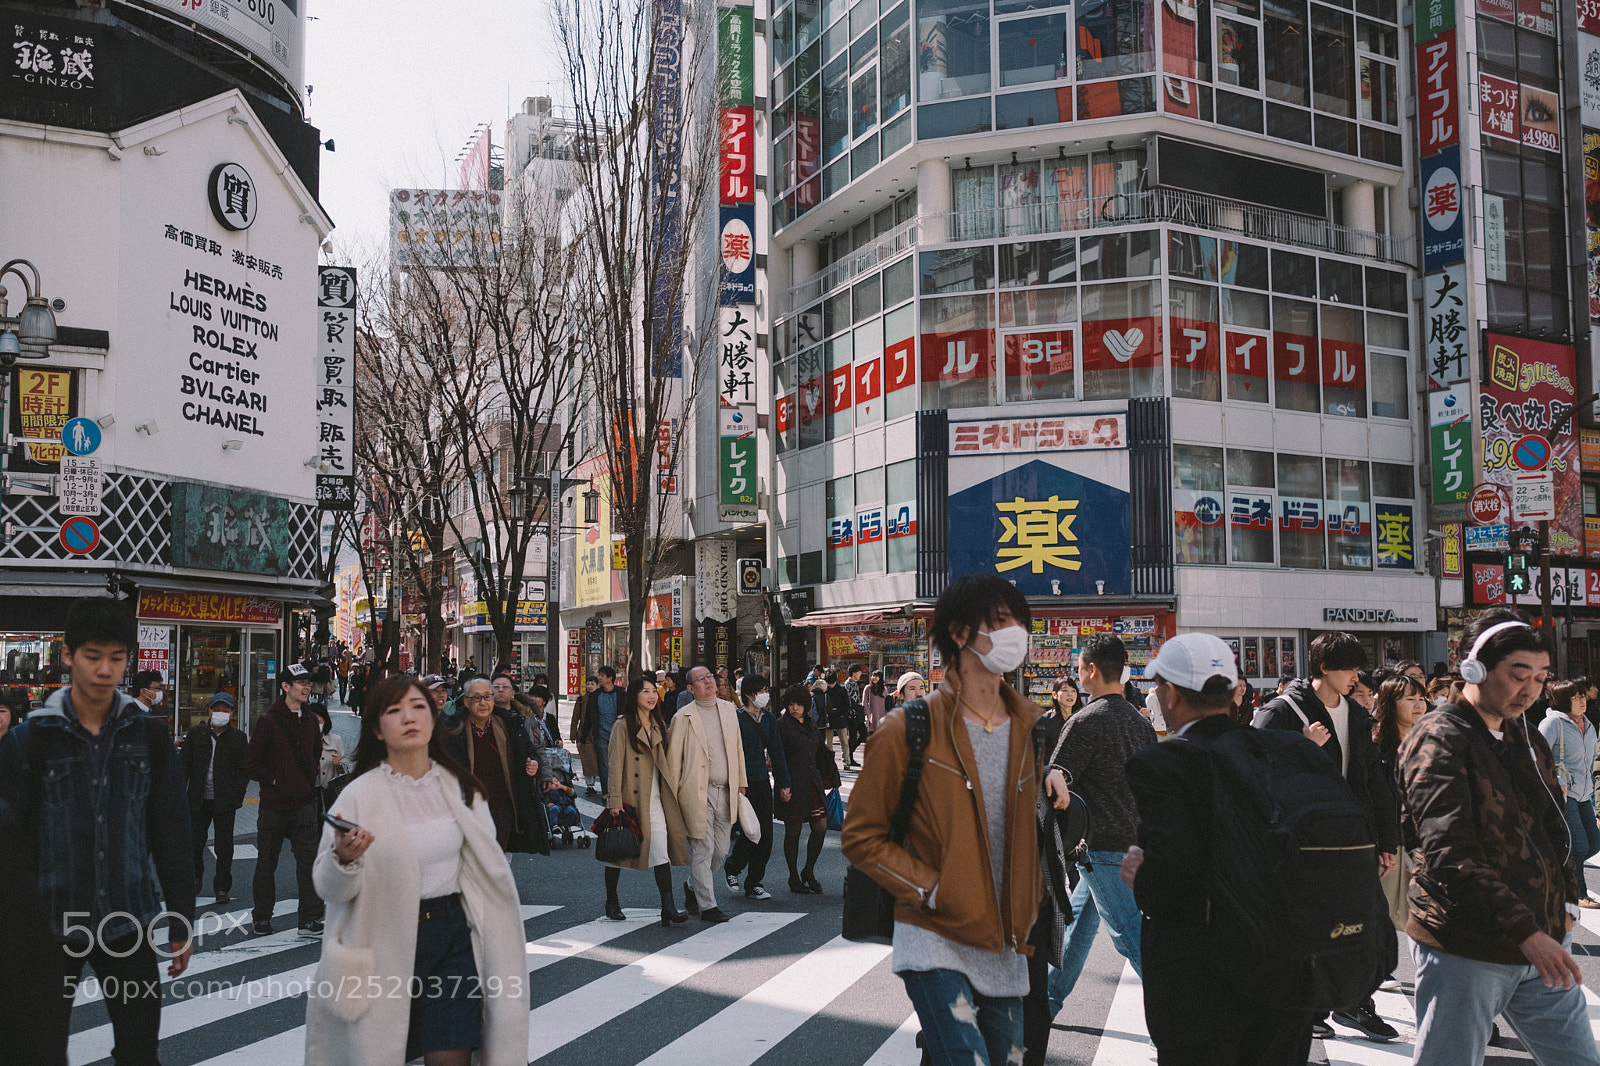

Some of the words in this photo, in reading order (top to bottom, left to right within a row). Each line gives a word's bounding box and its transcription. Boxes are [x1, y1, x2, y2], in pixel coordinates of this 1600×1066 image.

[24, 73, 83, 90] GINZO
[1425, 41, 1453, 145] アイフル
[1480, 80, 1519, 111] まつげ
[727, 113, 749, 198] アイフル
[224, 171, 251, 223] 質
[1427, 182, 1458, 218] 薬
[164, 224, 223, 257] 高価買取
[231, 249, 284, 282] 激安販売
[723, 233, 751, 260] 薬
[183, 268, 268, 313] HERMÈS
[320, 272, 351, 304] 質
[169, 291, 213, 322] LOUIS
[220, 307, 279, 342] VUITTON
[1428, 273, 1469, 380] 大勝軒
[192, 324, 258, 361] ROLEX
[721, 309, 755, 401] 大勝軒
[1021, 339, 1062, 364] 3F
[1182, 327, 1356, 383] アイフル
[189, 351, 261, 386] Cartier
[1495, 366, 1515, 387] 焼肉
[1496, 351, 1516, 372] 炭火
[28, 372, 61, 395] 2F
[180, 374, 268, 414] BVLGARI
[21, 395, 66, 415] 時計
[182, 401, 265, 437] CHANEL
[779, 402, 793, 423] 3F
[729, 441, 747, 495] レイク
[1442, 430, 1463, 493] レイク
[320, 477, 345, 487] 2号店
[1516, 486, 1528, 495] 22
[551, 482, 559, 526] SHINJUKU
[739, 495, 754, 503] B2F
[1473, 499, 1500, 513] 消火栓
[551, 529, 559, 548] MOA
[994, 494, 1082, 574] 薬
[1376, 511, 1413, 561] 薬
[1476, 525, 1509, 539] セキネ
[551, 560, 559, 592] Avenue
[720, 546, 728, 589] BRAND
[1031, 619, 1046, 634] 薬
[1323, 607, 1398, 623] PANDORA
[140, 627, 168, 642] ヴィトン
[143, 650, 165, 659] 中古品
